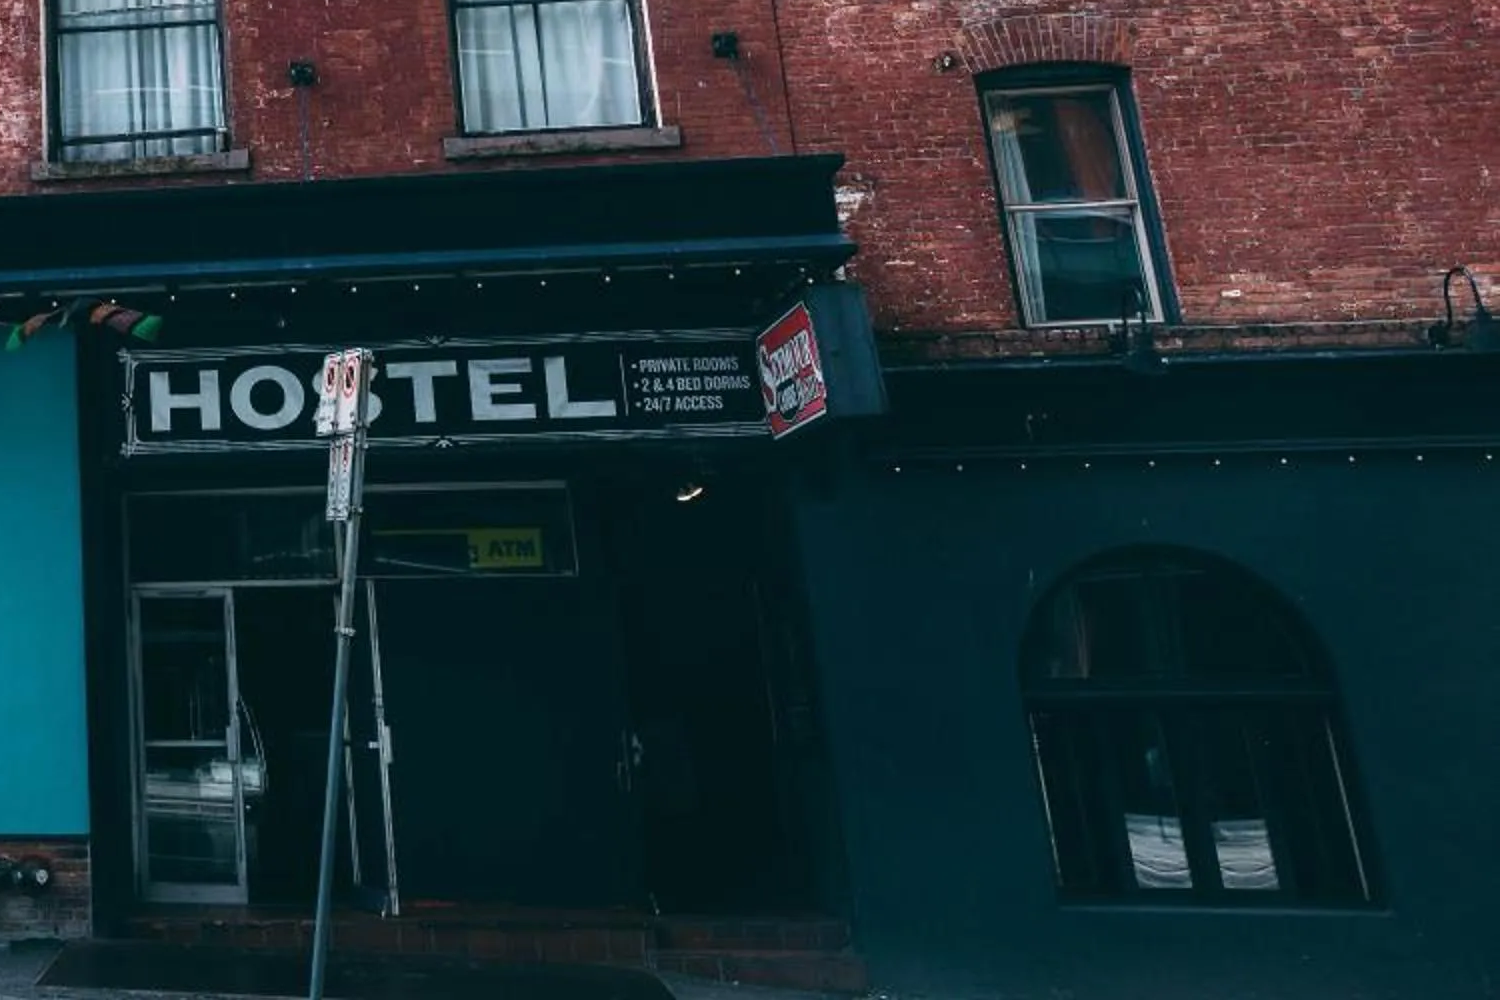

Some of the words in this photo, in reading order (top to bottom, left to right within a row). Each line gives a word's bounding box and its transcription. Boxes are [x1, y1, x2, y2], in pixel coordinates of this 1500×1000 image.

[639, 357, 691, 373] PRIVATE
[693, 355, 739, 371] ROOMS
[641, 377, 651, 392] 2
[652, 377, 665, 392] &
[665, 377, 675, 391] 4
[676, 376, 702, 391] BED
[703, 375, 751, 391] DORMS
[643, 395, 672, 412] 24/7
[674, 394, 724, 412] ACCESS
[489, 540, 536, 559] ATM
